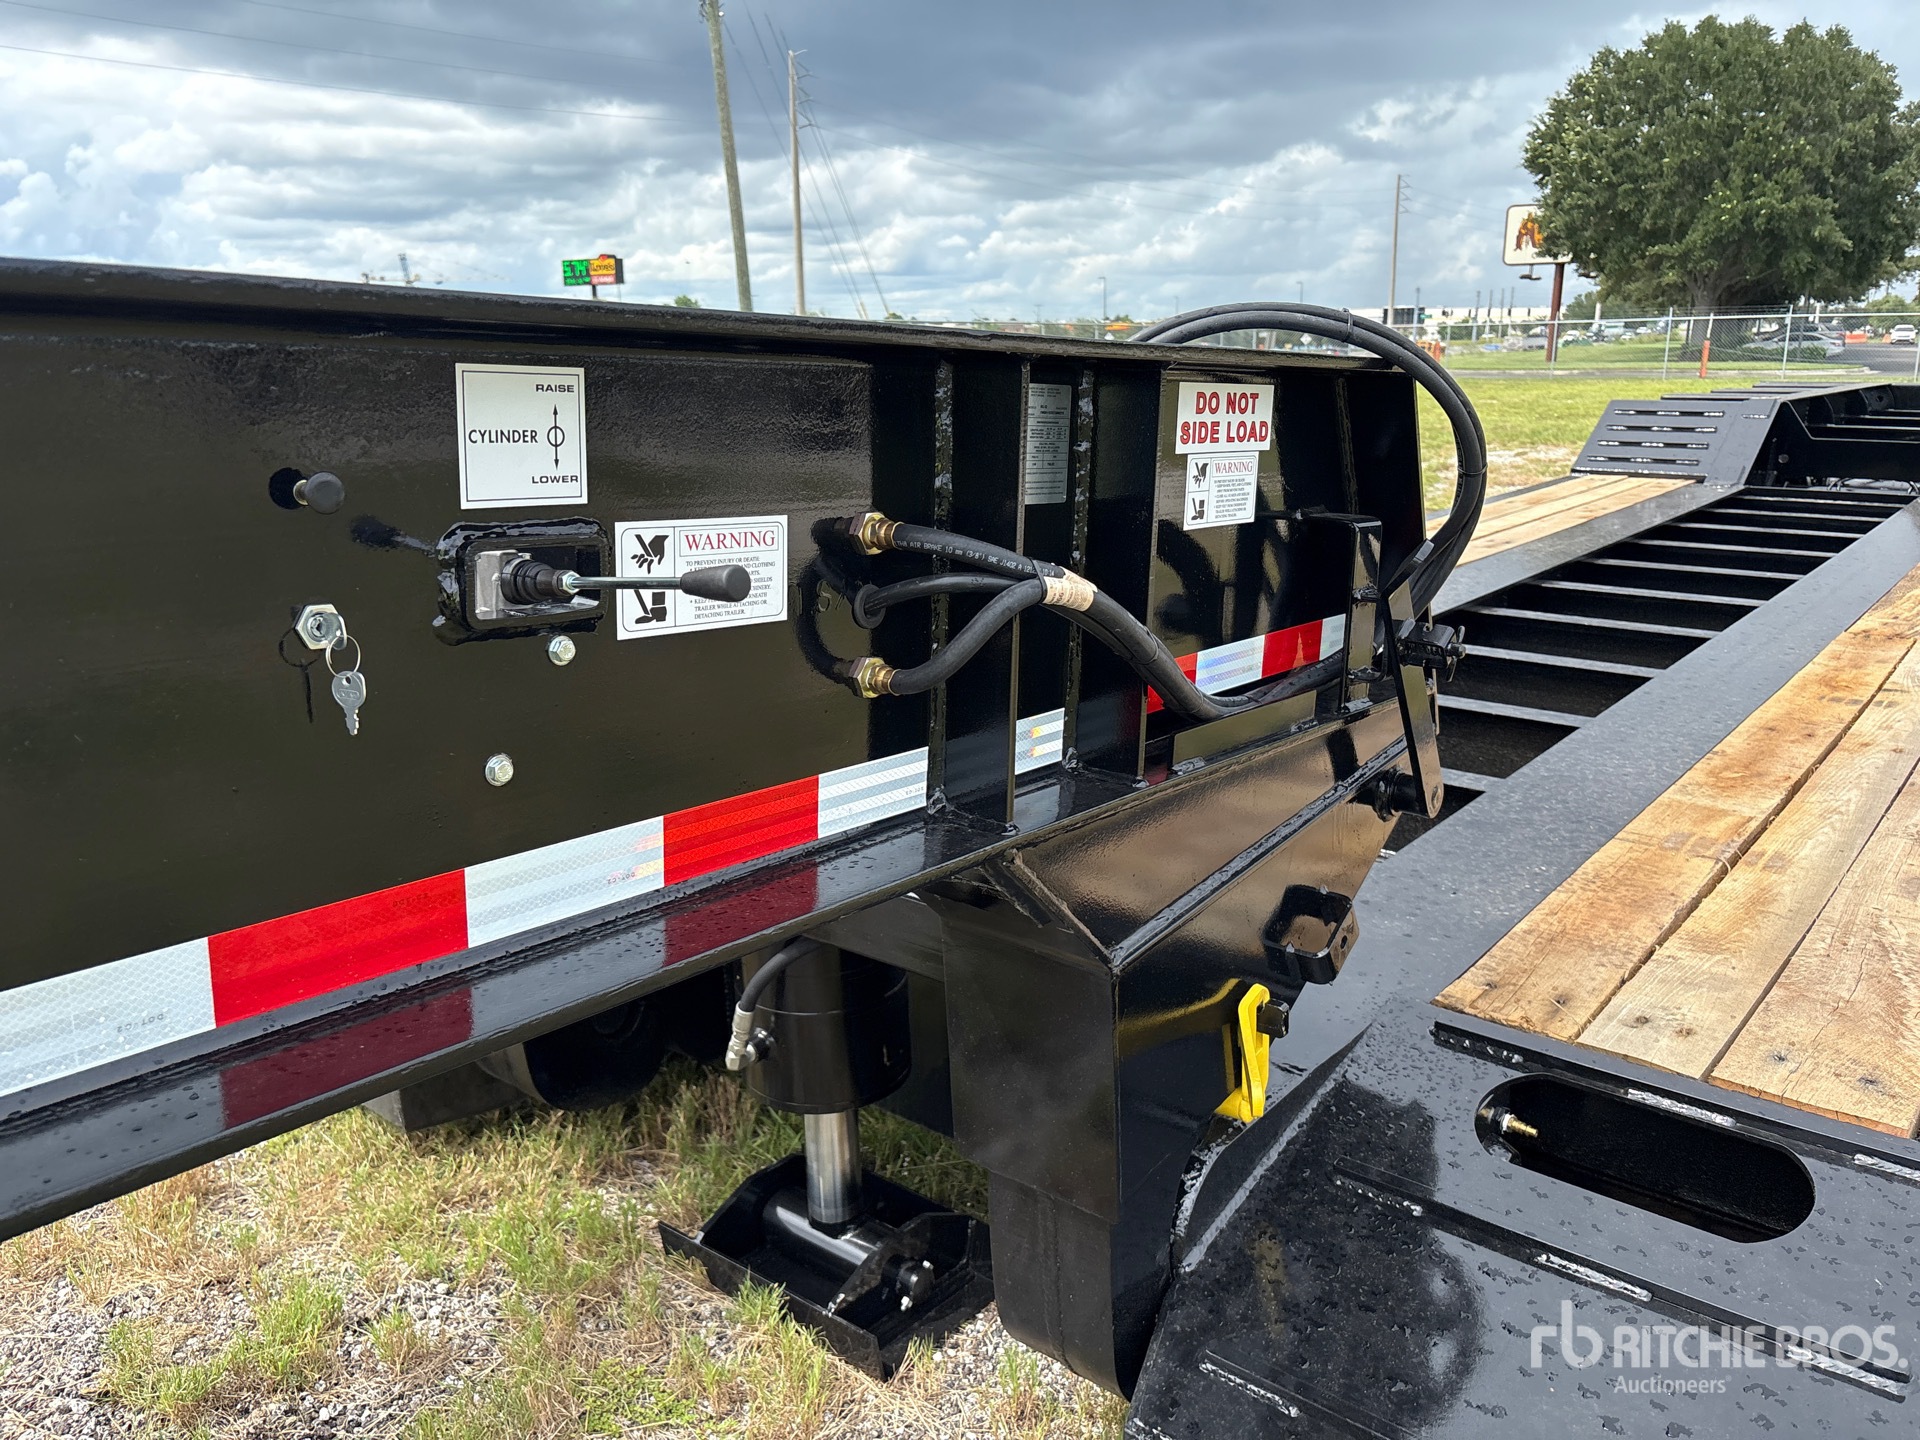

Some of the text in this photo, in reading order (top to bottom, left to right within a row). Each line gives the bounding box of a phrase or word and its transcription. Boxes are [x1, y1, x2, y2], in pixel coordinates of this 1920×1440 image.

[535, 384, 575, 393] RAISE
[1195, 391, 1259, 415] DO NOT
[468, 429, 539, 444] CYLINDER
[1180, 420, 1269, 445] SIDE LOAD
[1214, 461, 1253, 474] WARNING
[531, 475, 579, 484] LOWER
[684, 530, 775, 551] WARNING
[923, 543, 943, 552] BRAKE
[945, 546, 953, 554] 10
[694, 558, 717, 566] PREVENT
[717, 557, 735, 565] INJURY
[694, 604, 716, 612] TRAILER
